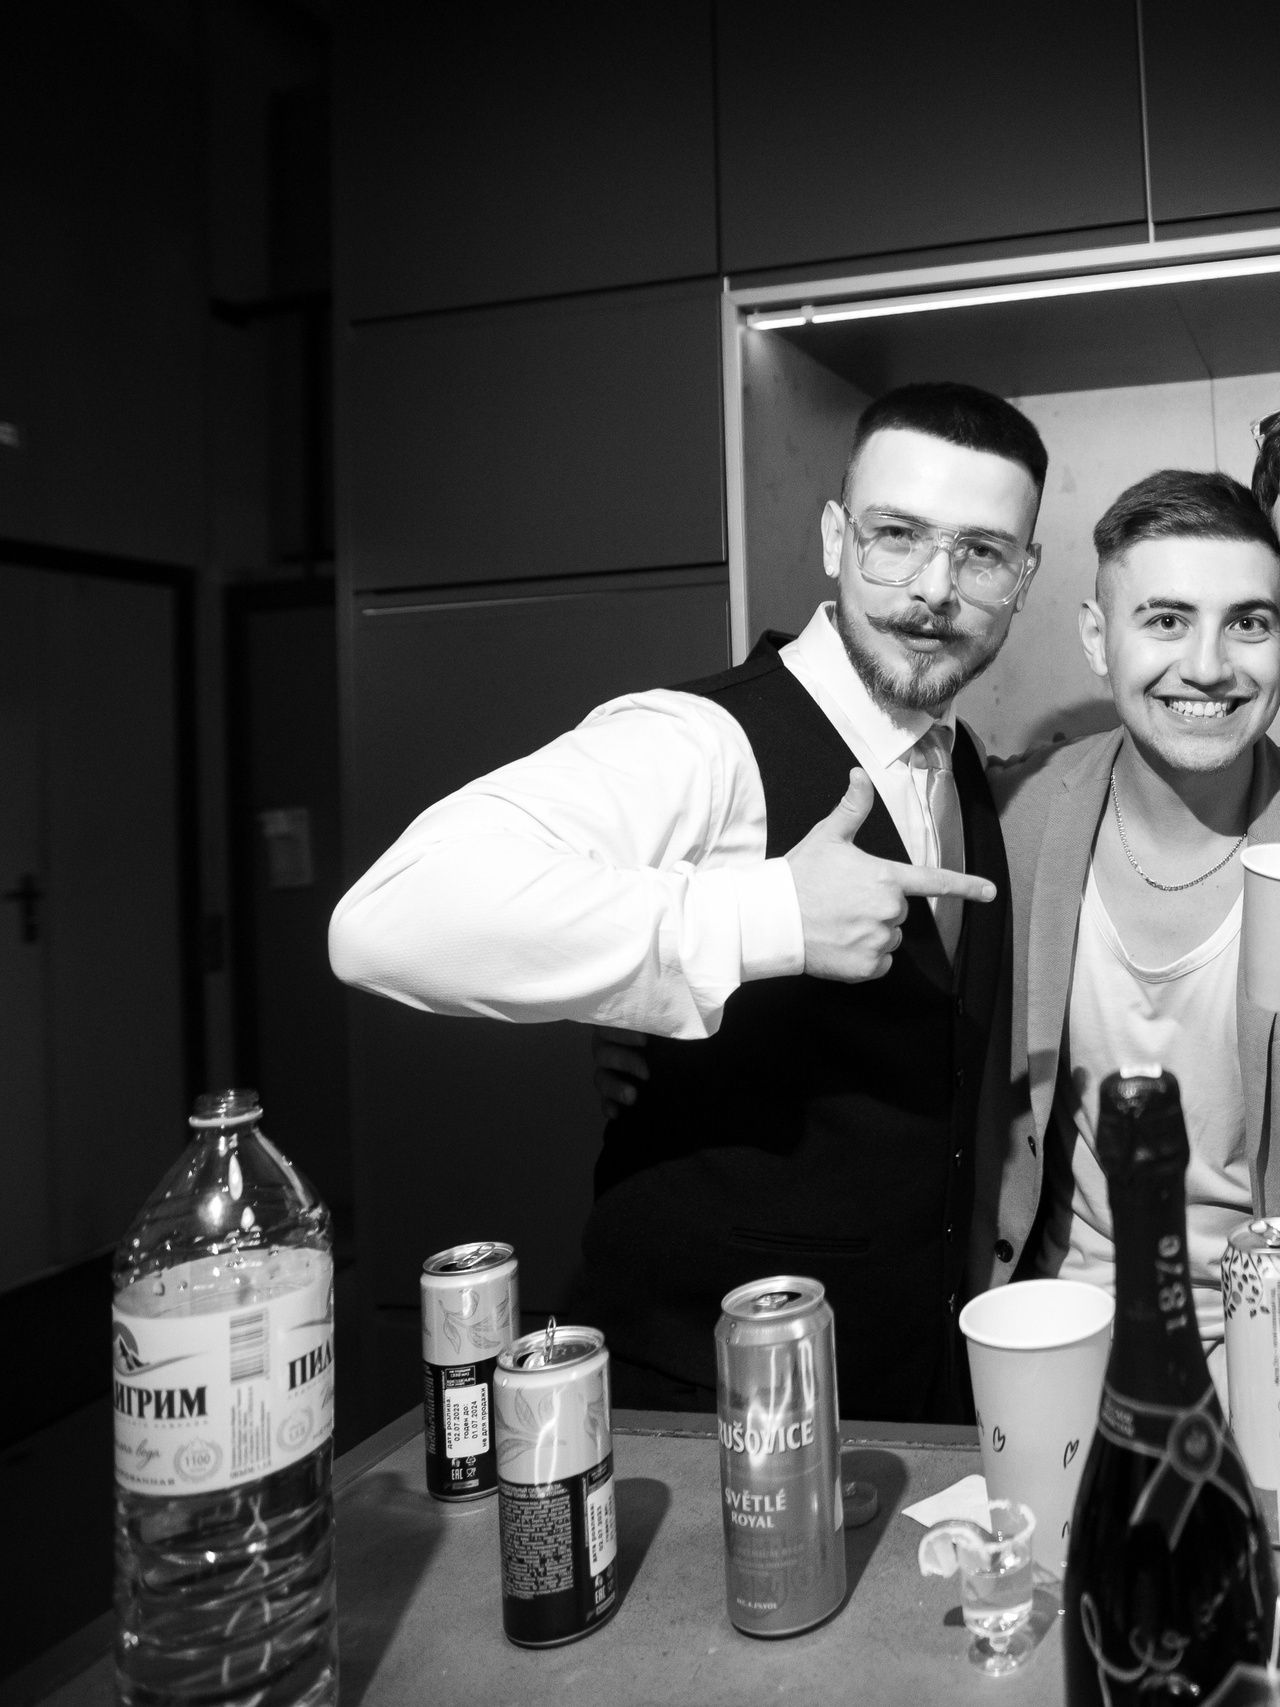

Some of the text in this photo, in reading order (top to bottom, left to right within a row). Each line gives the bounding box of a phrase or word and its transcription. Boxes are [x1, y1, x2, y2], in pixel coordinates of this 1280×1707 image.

[482, 1438, 487, 1448] не
[725, 1486, 787, 1513] SVĚTLÉ
[731, 1510, 776, 1529] ROYAL
